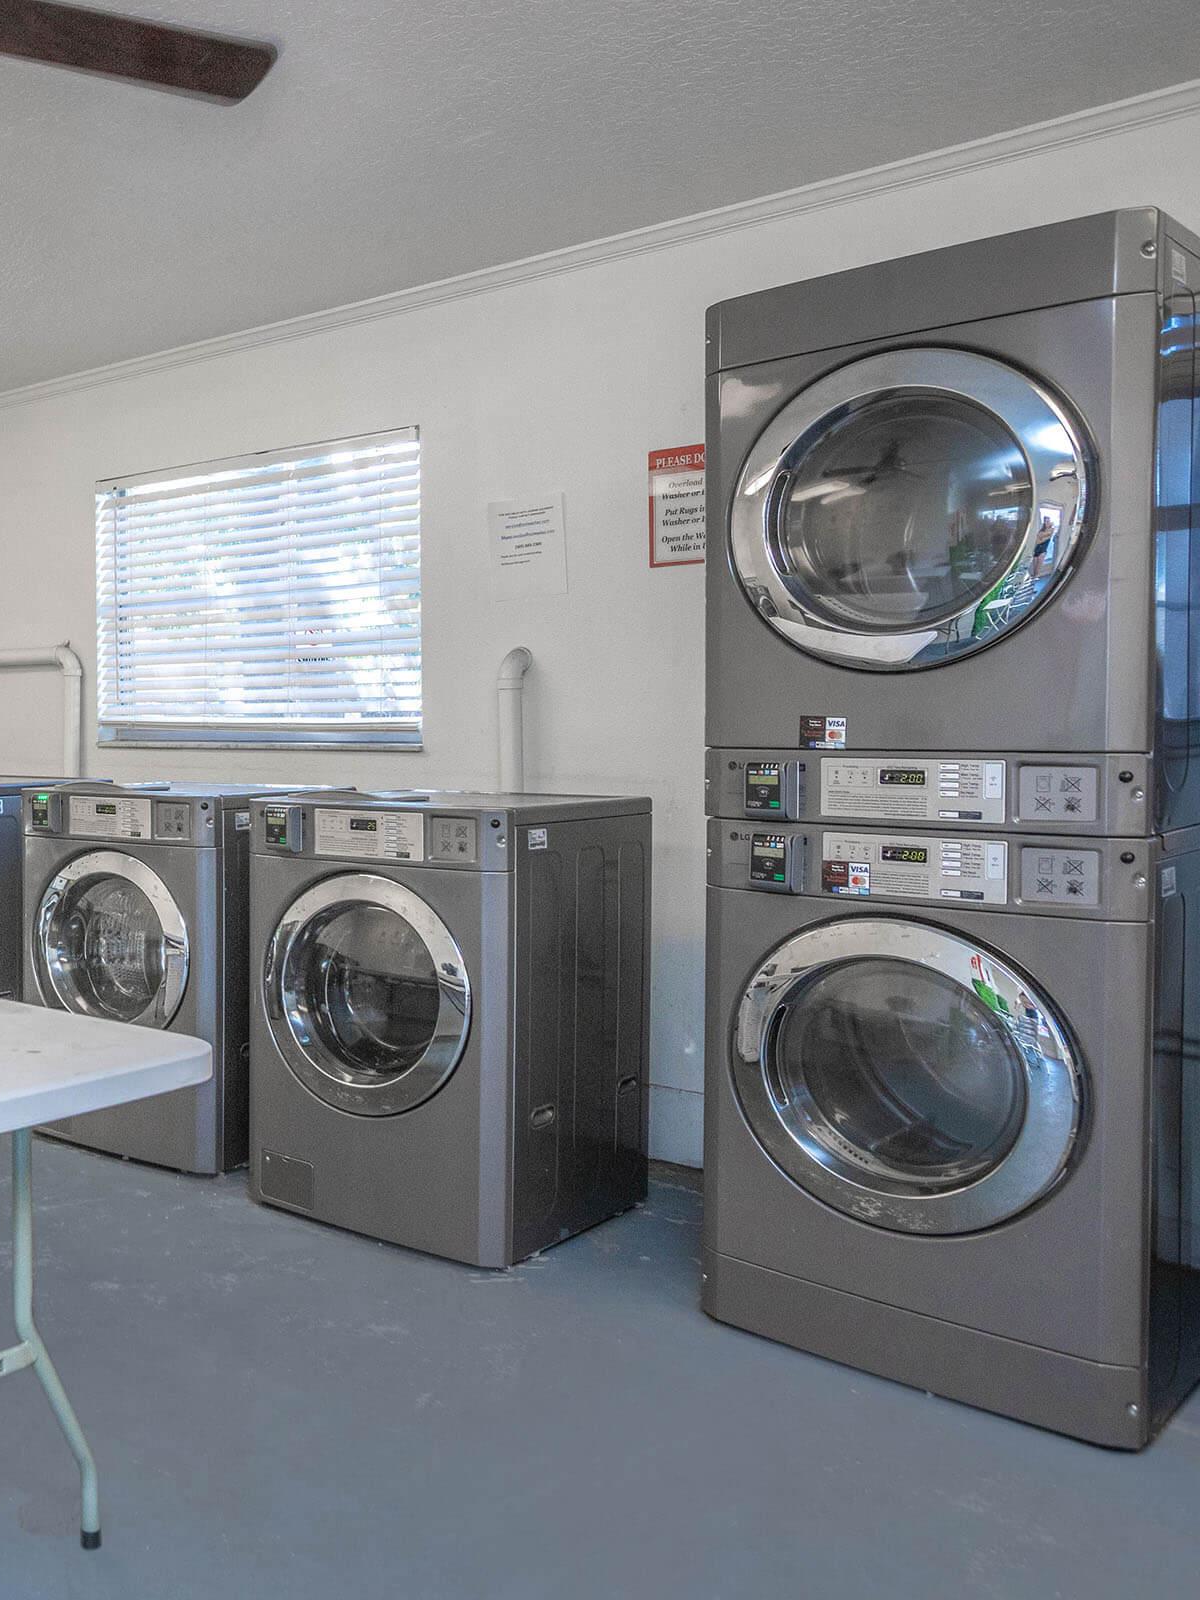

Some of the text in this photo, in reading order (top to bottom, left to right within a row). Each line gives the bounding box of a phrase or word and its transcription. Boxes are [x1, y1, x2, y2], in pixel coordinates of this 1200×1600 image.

[656, 454, 692, 469] PLEASE
[668, 477, 703, 489] Overload
[662, 491, 690, 500] Washer
[665, 508, 678, 516] Put
[679, 506, 698, 515] Rugs
[662, 517, 690, 527] Washer
[661, 535, 680, 544] Open
[682, 533, 694, 541] the
[670, 543, 692, 552] While
[827, 719, 845, 727] VISA
[850, 865, 869, 873] VISA
